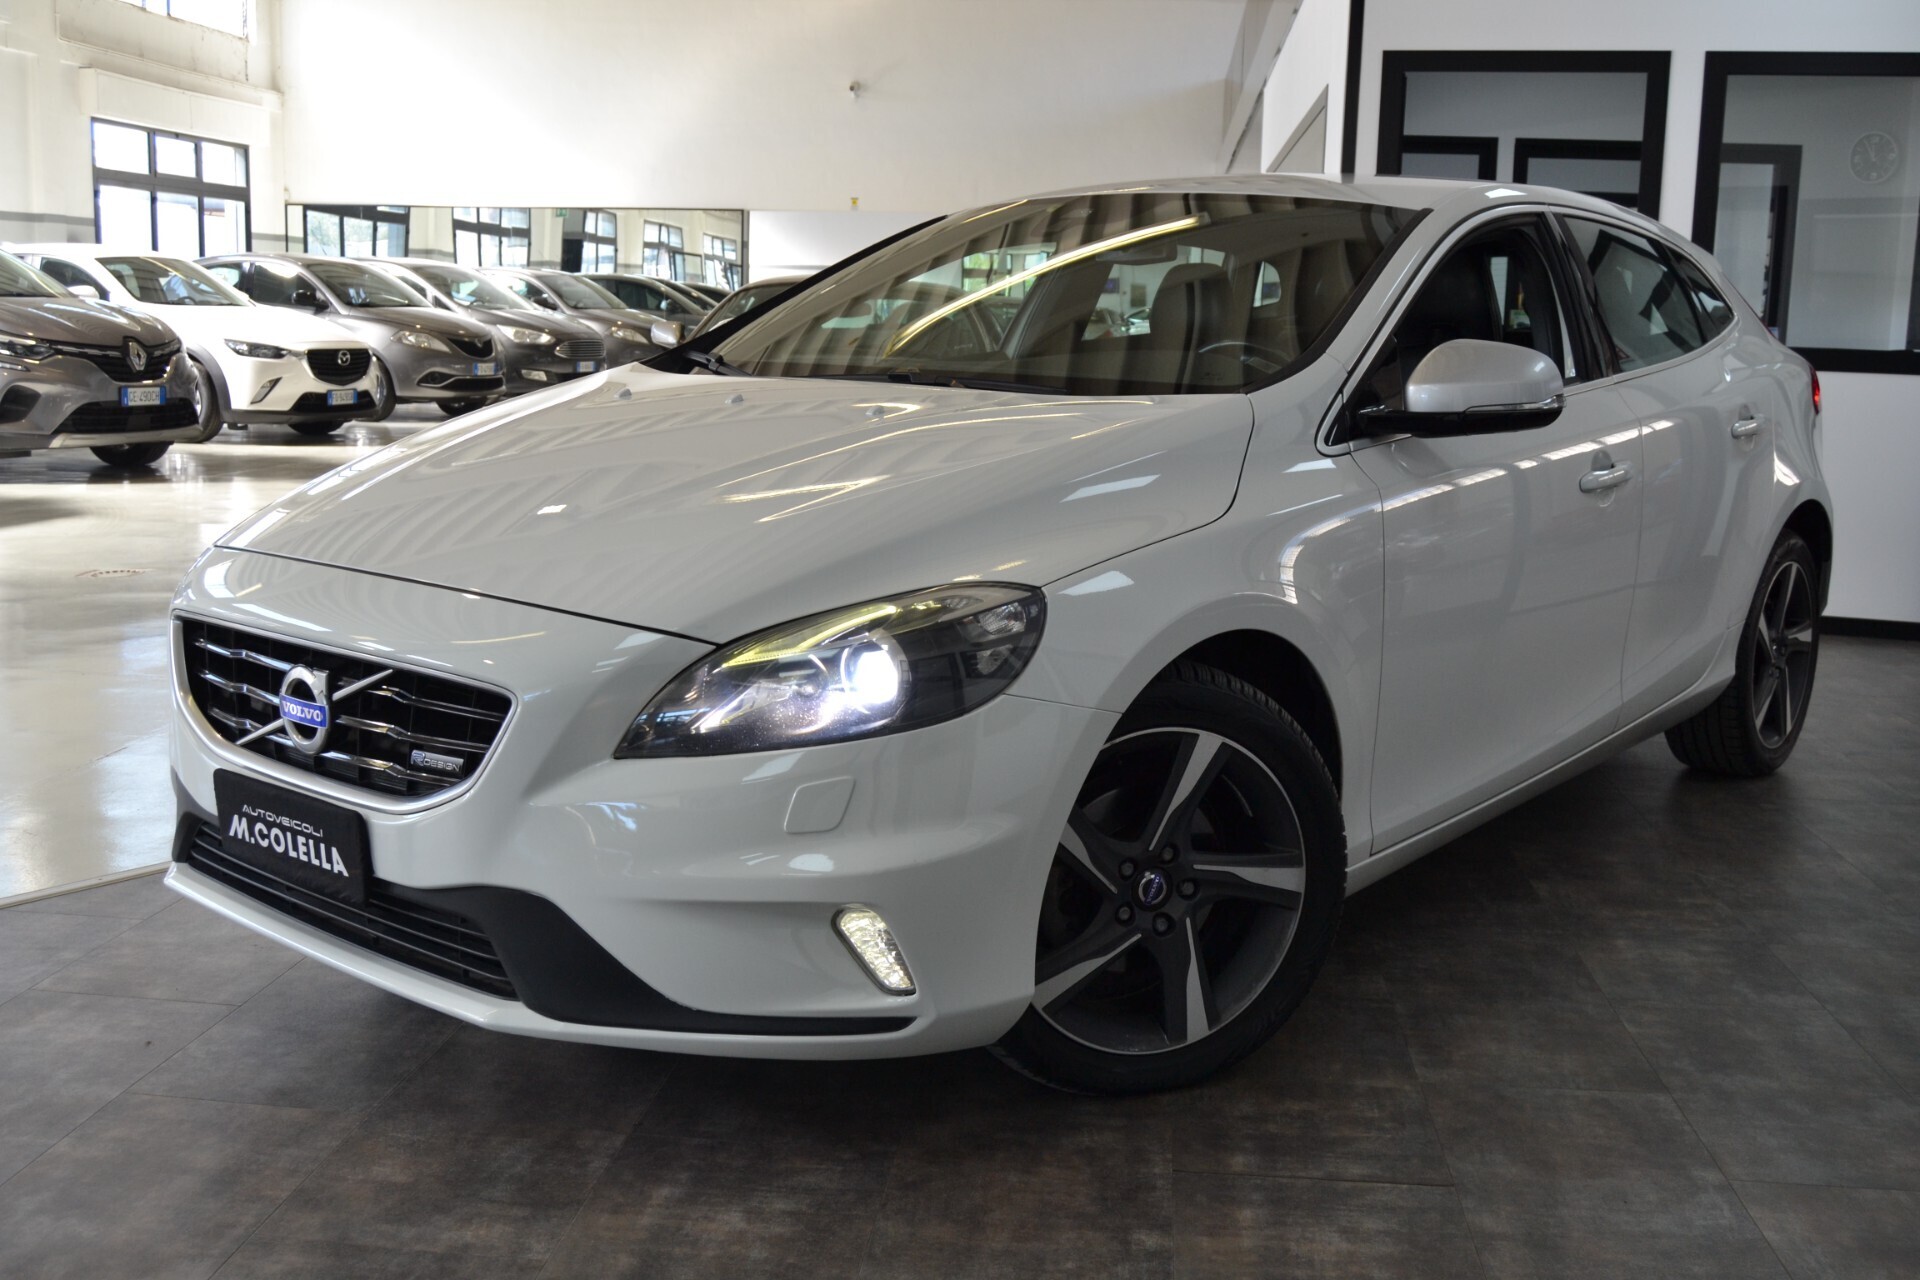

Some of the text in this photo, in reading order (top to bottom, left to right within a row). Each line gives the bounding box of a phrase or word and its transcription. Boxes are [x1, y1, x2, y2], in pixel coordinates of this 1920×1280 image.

[282, 700, 323, 722] VOLVO
[242, 804, 323, 838] AUTOVEICOLI
[229, 814, 349, 877] M.COLELLA
